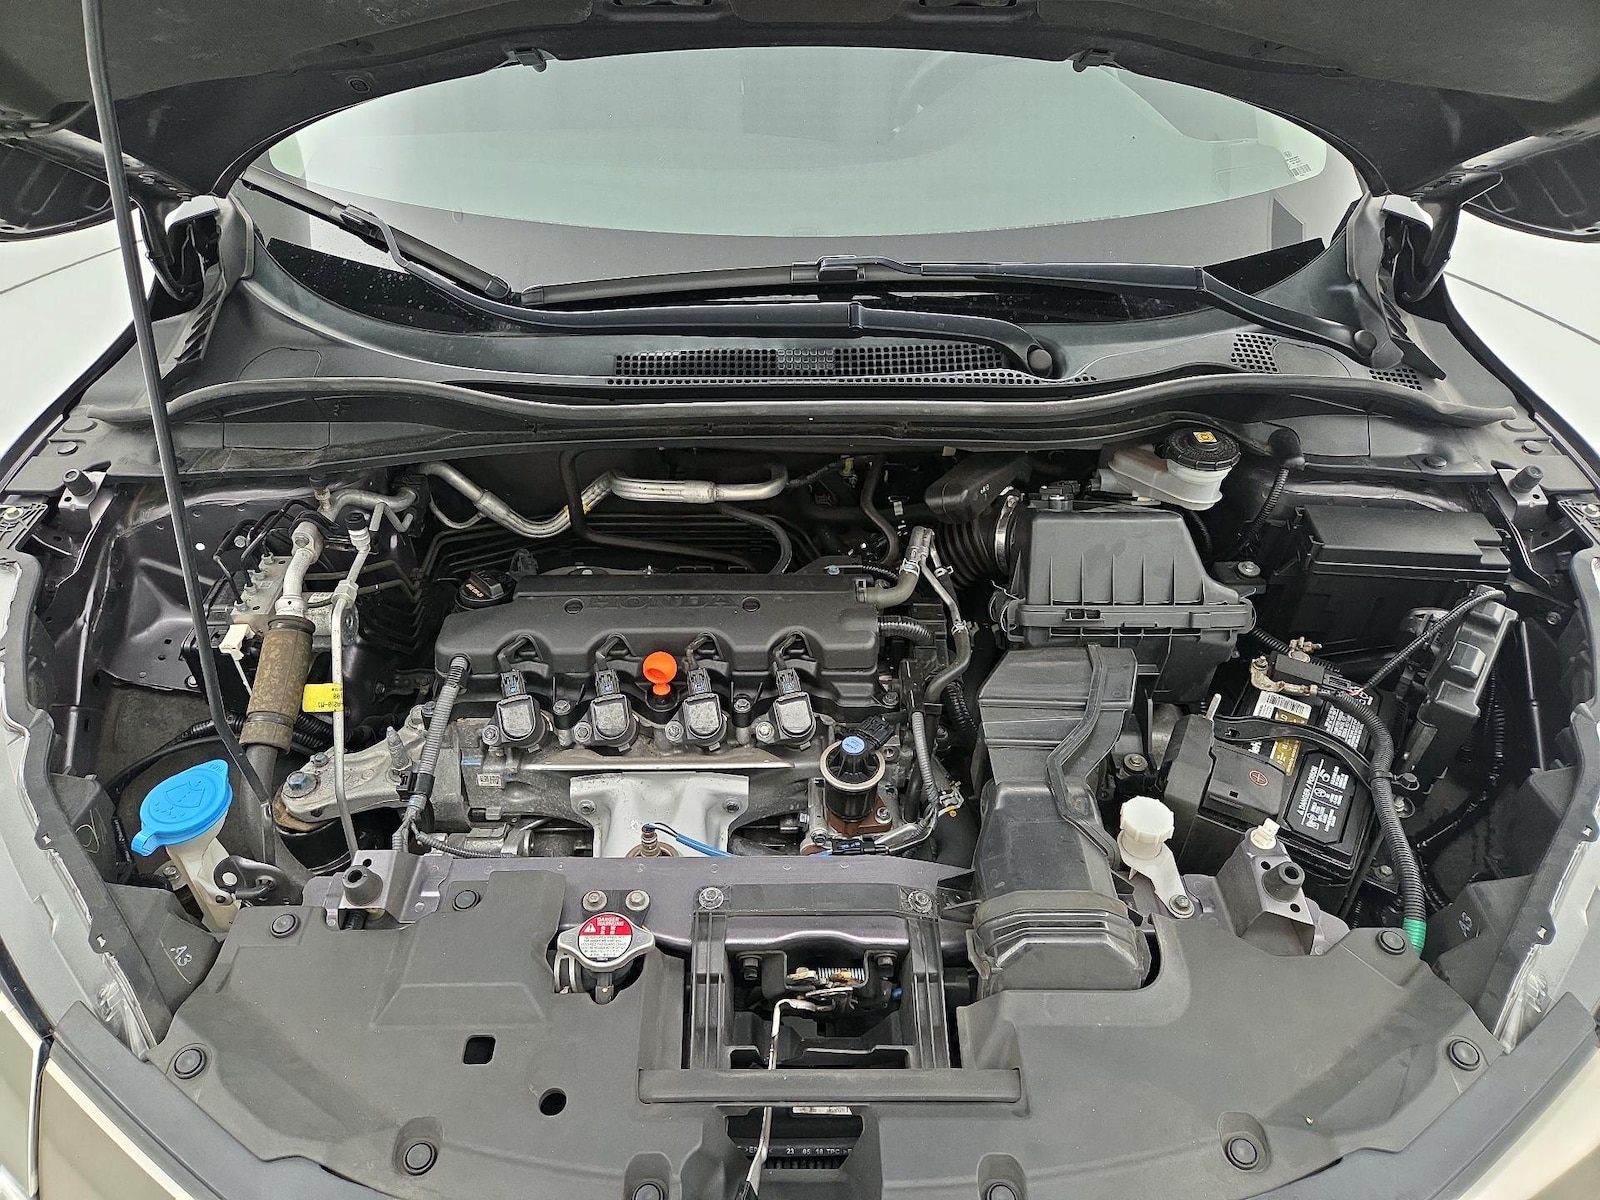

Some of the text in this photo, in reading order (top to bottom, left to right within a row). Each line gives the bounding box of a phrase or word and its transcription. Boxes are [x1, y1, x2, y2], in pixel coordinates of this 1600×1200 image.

[588, 595, 739, 608] HONDA
[1299, 787, 1312, 810] DANGER
[1306, 765, 1319, 785] POISON
